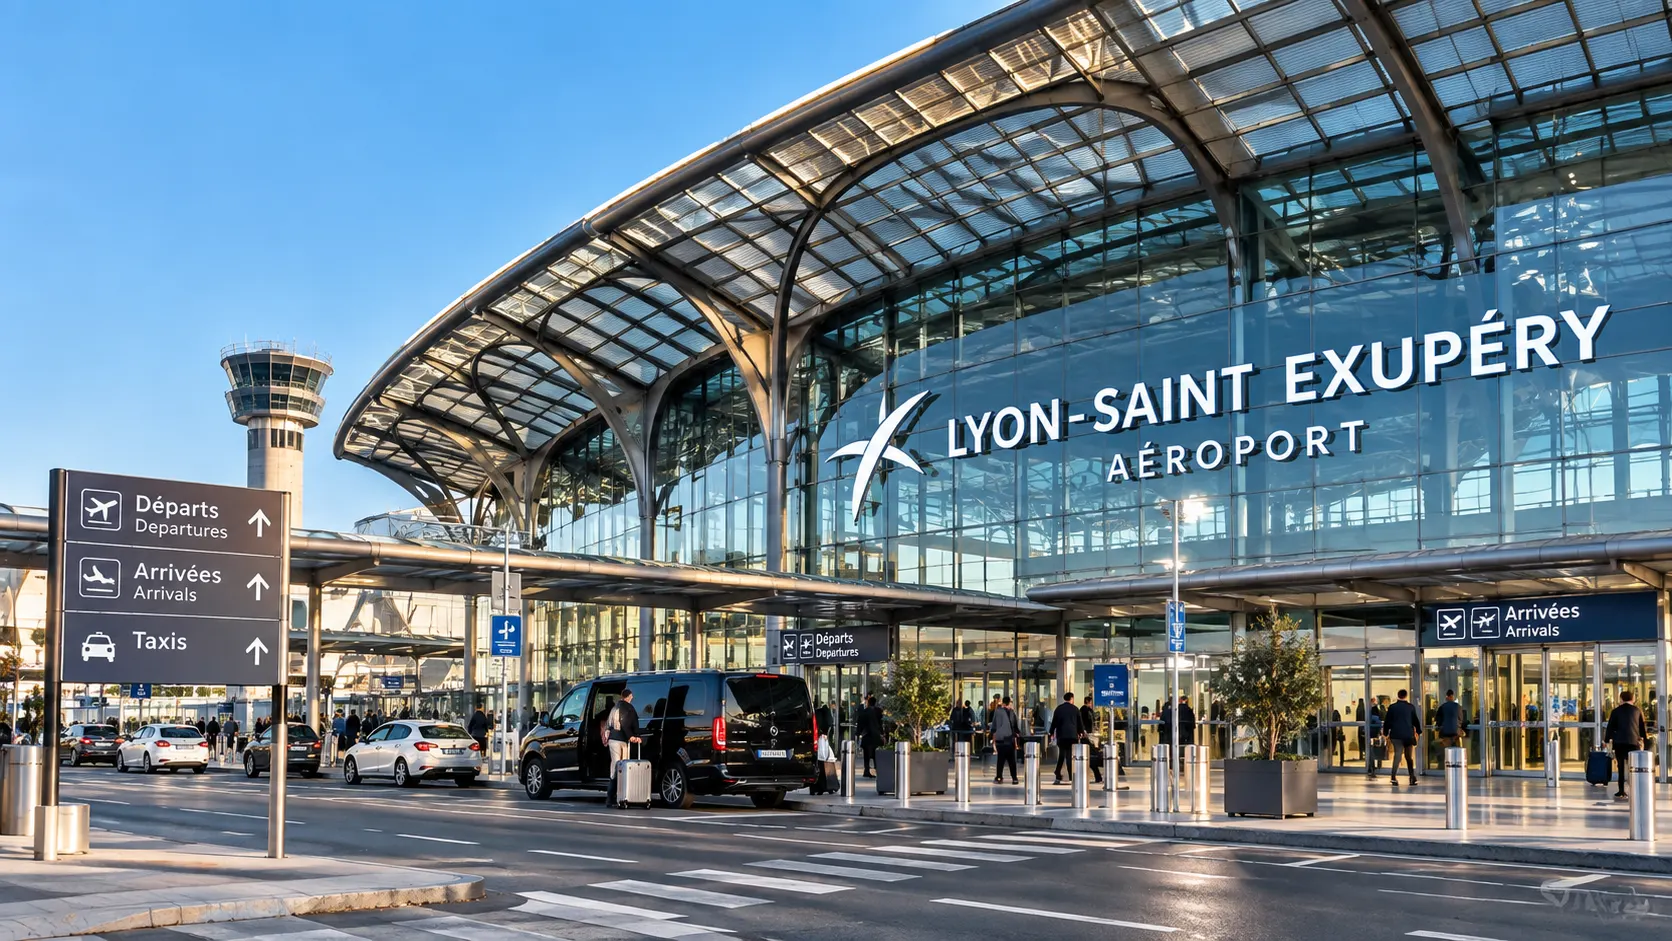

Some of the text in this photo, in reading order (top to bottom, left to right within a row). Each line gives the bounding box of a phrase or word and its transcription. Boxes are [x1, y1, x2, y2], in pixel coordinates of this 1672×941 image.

[1284, 304, 1611, 405] EXUPÉRY
[1106, 421, 1369, 483] AÉROPORT
[135, 494, 219, 520] Départs
[135, 518, 228, 539] Departures
[134, 562, 222, 585] Arrivées
[134, 585, 197, 603] Arrivals
[1505, 603, 1580, 620] Arrivées
[816, 632, 854, 646] Départs
[1505, 623, 1560, 637] Arrivals
[133, 631, 187, 651] Taxis
[816, 647, 859, 659] Departures
